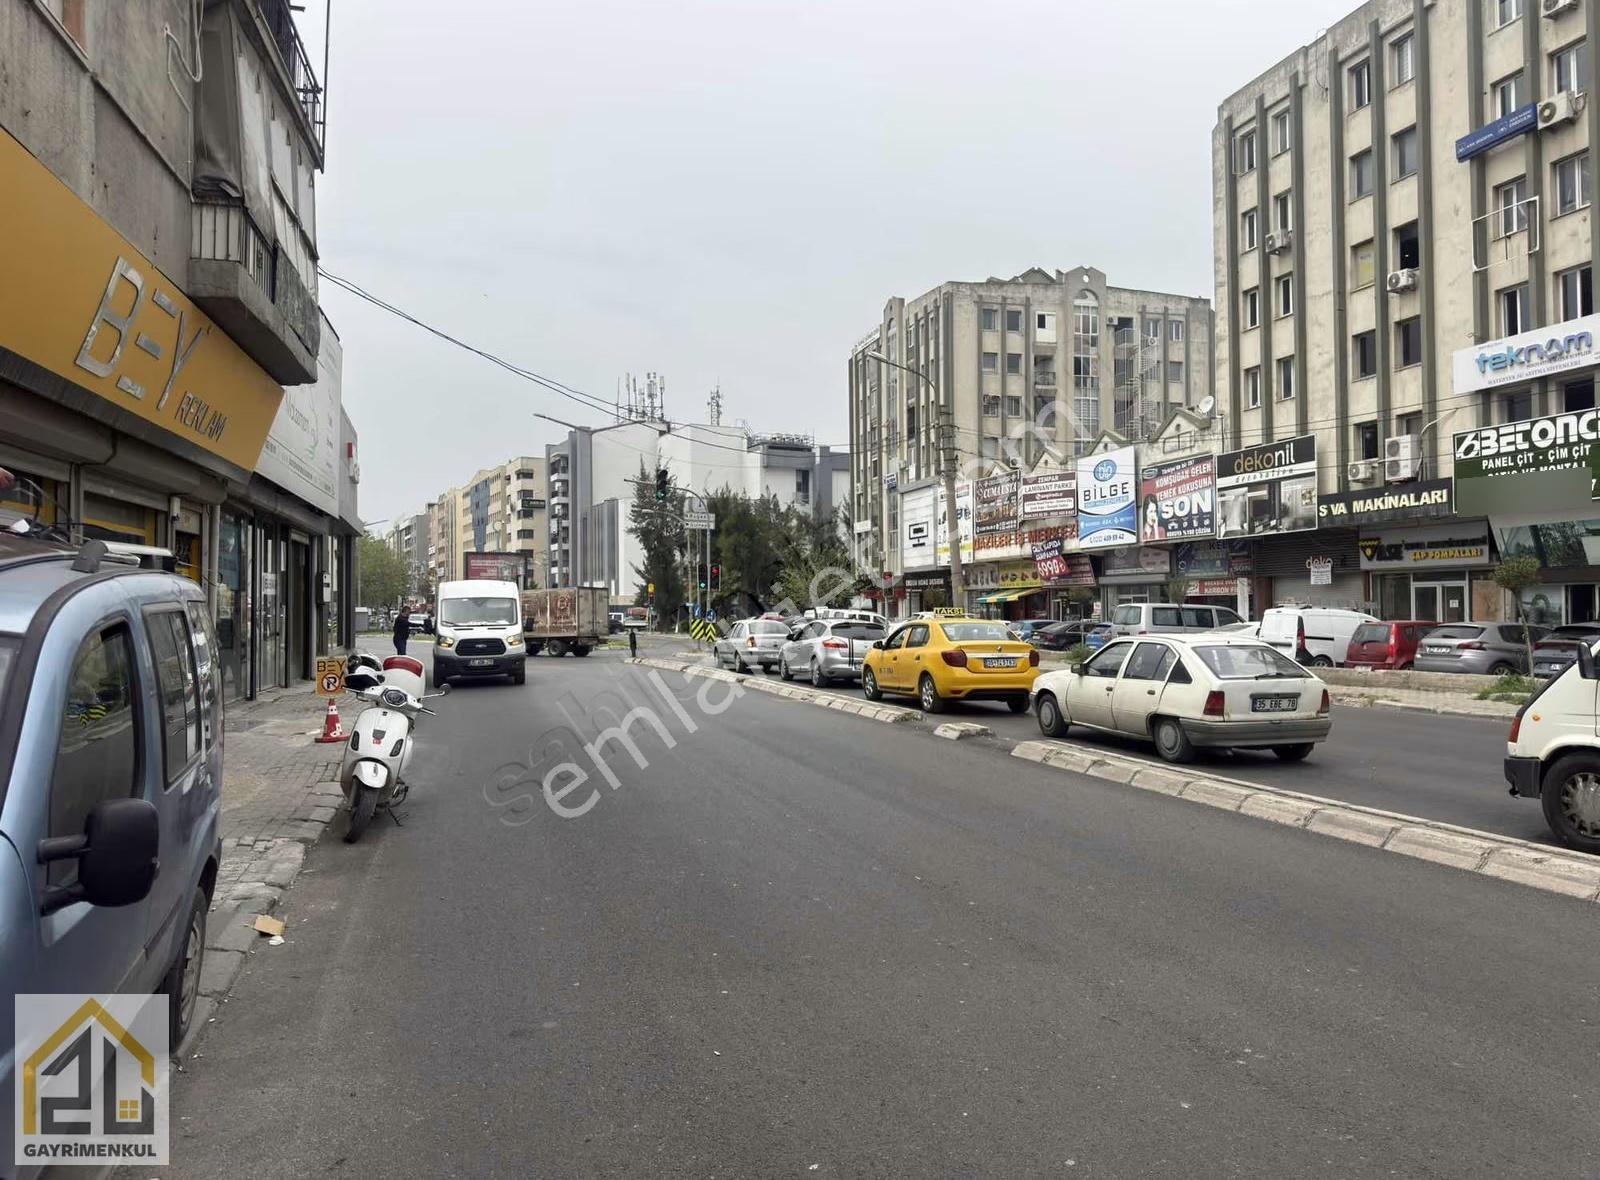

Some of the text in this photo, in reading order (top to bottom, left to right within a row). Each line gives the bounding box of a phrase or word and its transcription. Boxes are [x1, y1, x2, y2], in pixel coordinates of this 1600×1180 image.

[174, 390, 227, 442] REKLAM
[1190, 462, 1212, 476] GELEN
[1234, 442, 1295, 474] dekonil
[1482, 457, 1514, 470] PANEL
[1517, 451, 1534, 467] ÇİT
[1548, 446, 1568, 462] ÇİM
[1572, 443, 1591, 459] ÇİT
[1083, 482, 1129, 501] BİLGE
[1161, 488, 1212, 519] SON
[1352, 490, 1448, 514] MAKİNALARI
